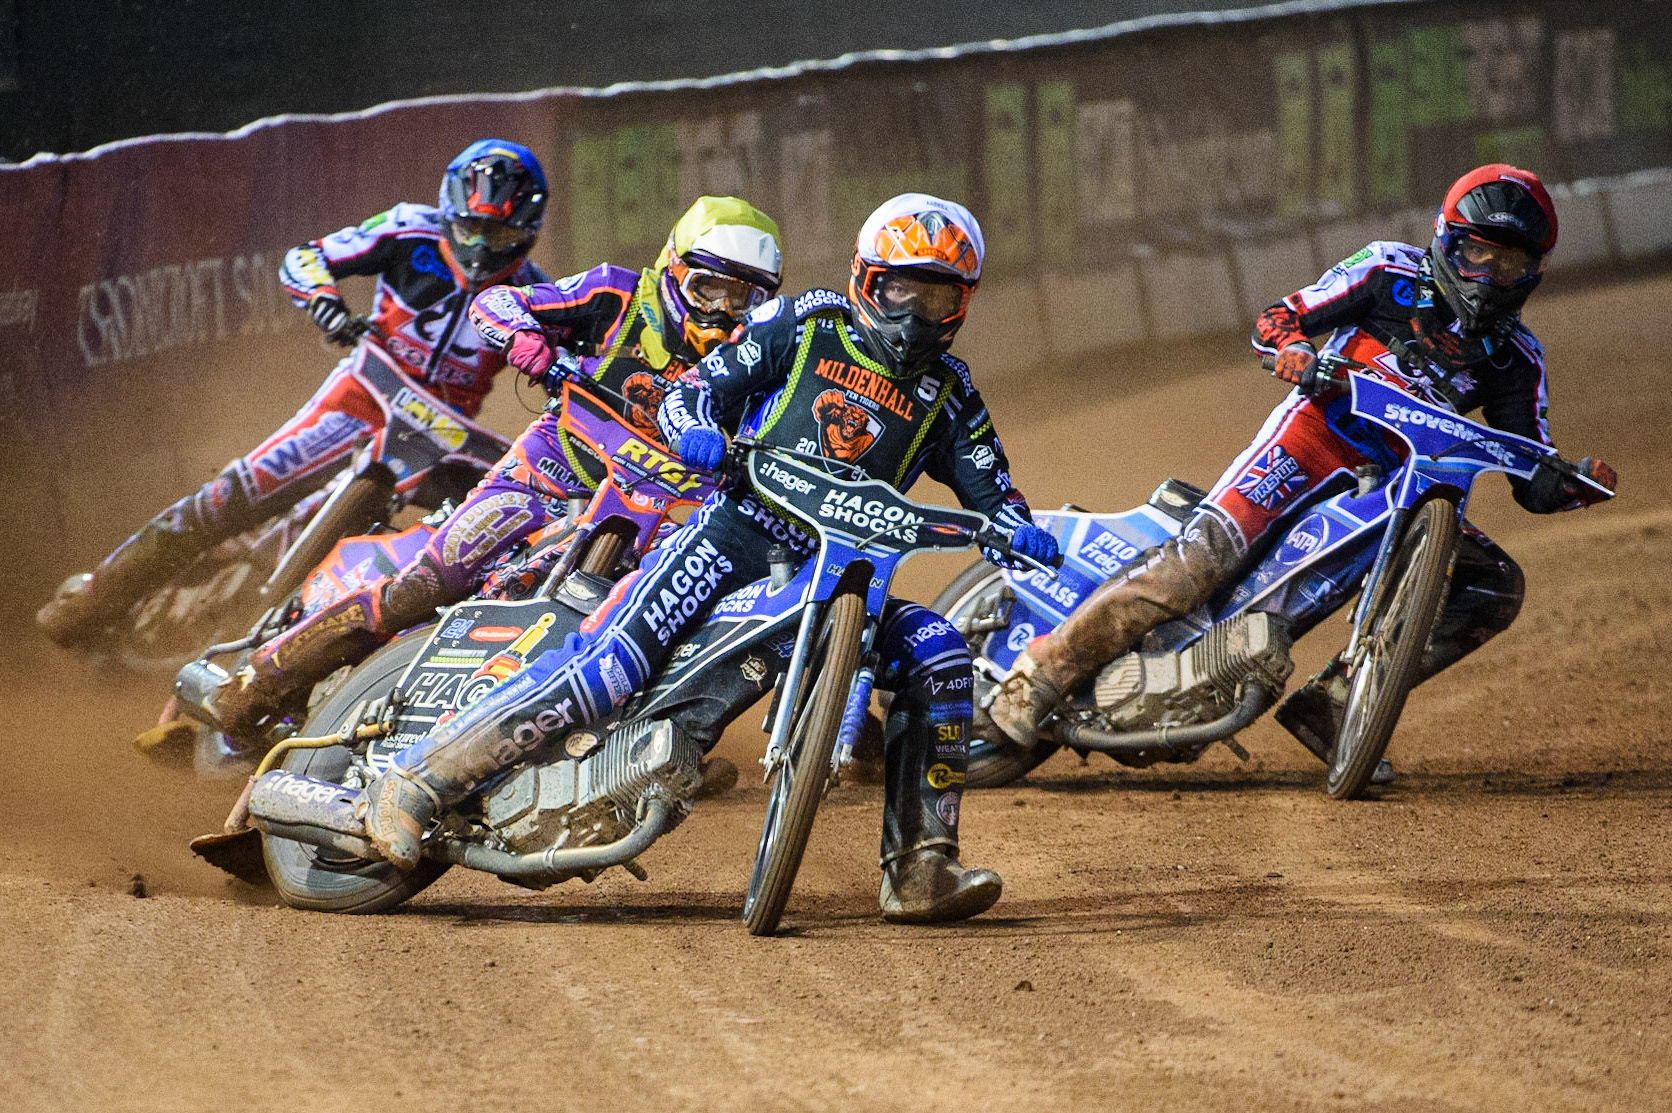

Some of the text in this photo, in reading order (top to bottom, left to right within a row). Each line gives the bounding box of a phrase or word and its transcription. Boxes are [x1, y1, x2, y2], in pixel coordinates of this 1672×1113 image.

[814, 358, 913, 422] MILDENHALL
[845, 389, 880, 411] FEN TIGERS
[917, 374, 941, 402] 5
[795, 437, 817, 455] 20
[818, 504, 919, 544] SHOCKS
[824, 489, 925, 531] HAGON
[1093, 530, 1138, 561] RYLO
[642, 538, 719, 633] HAGON
[827, 563, 884, 589] HAN
[1030, 572, 1079, 608] GLASS
[657, 555, 733, 647] SHOCKS
